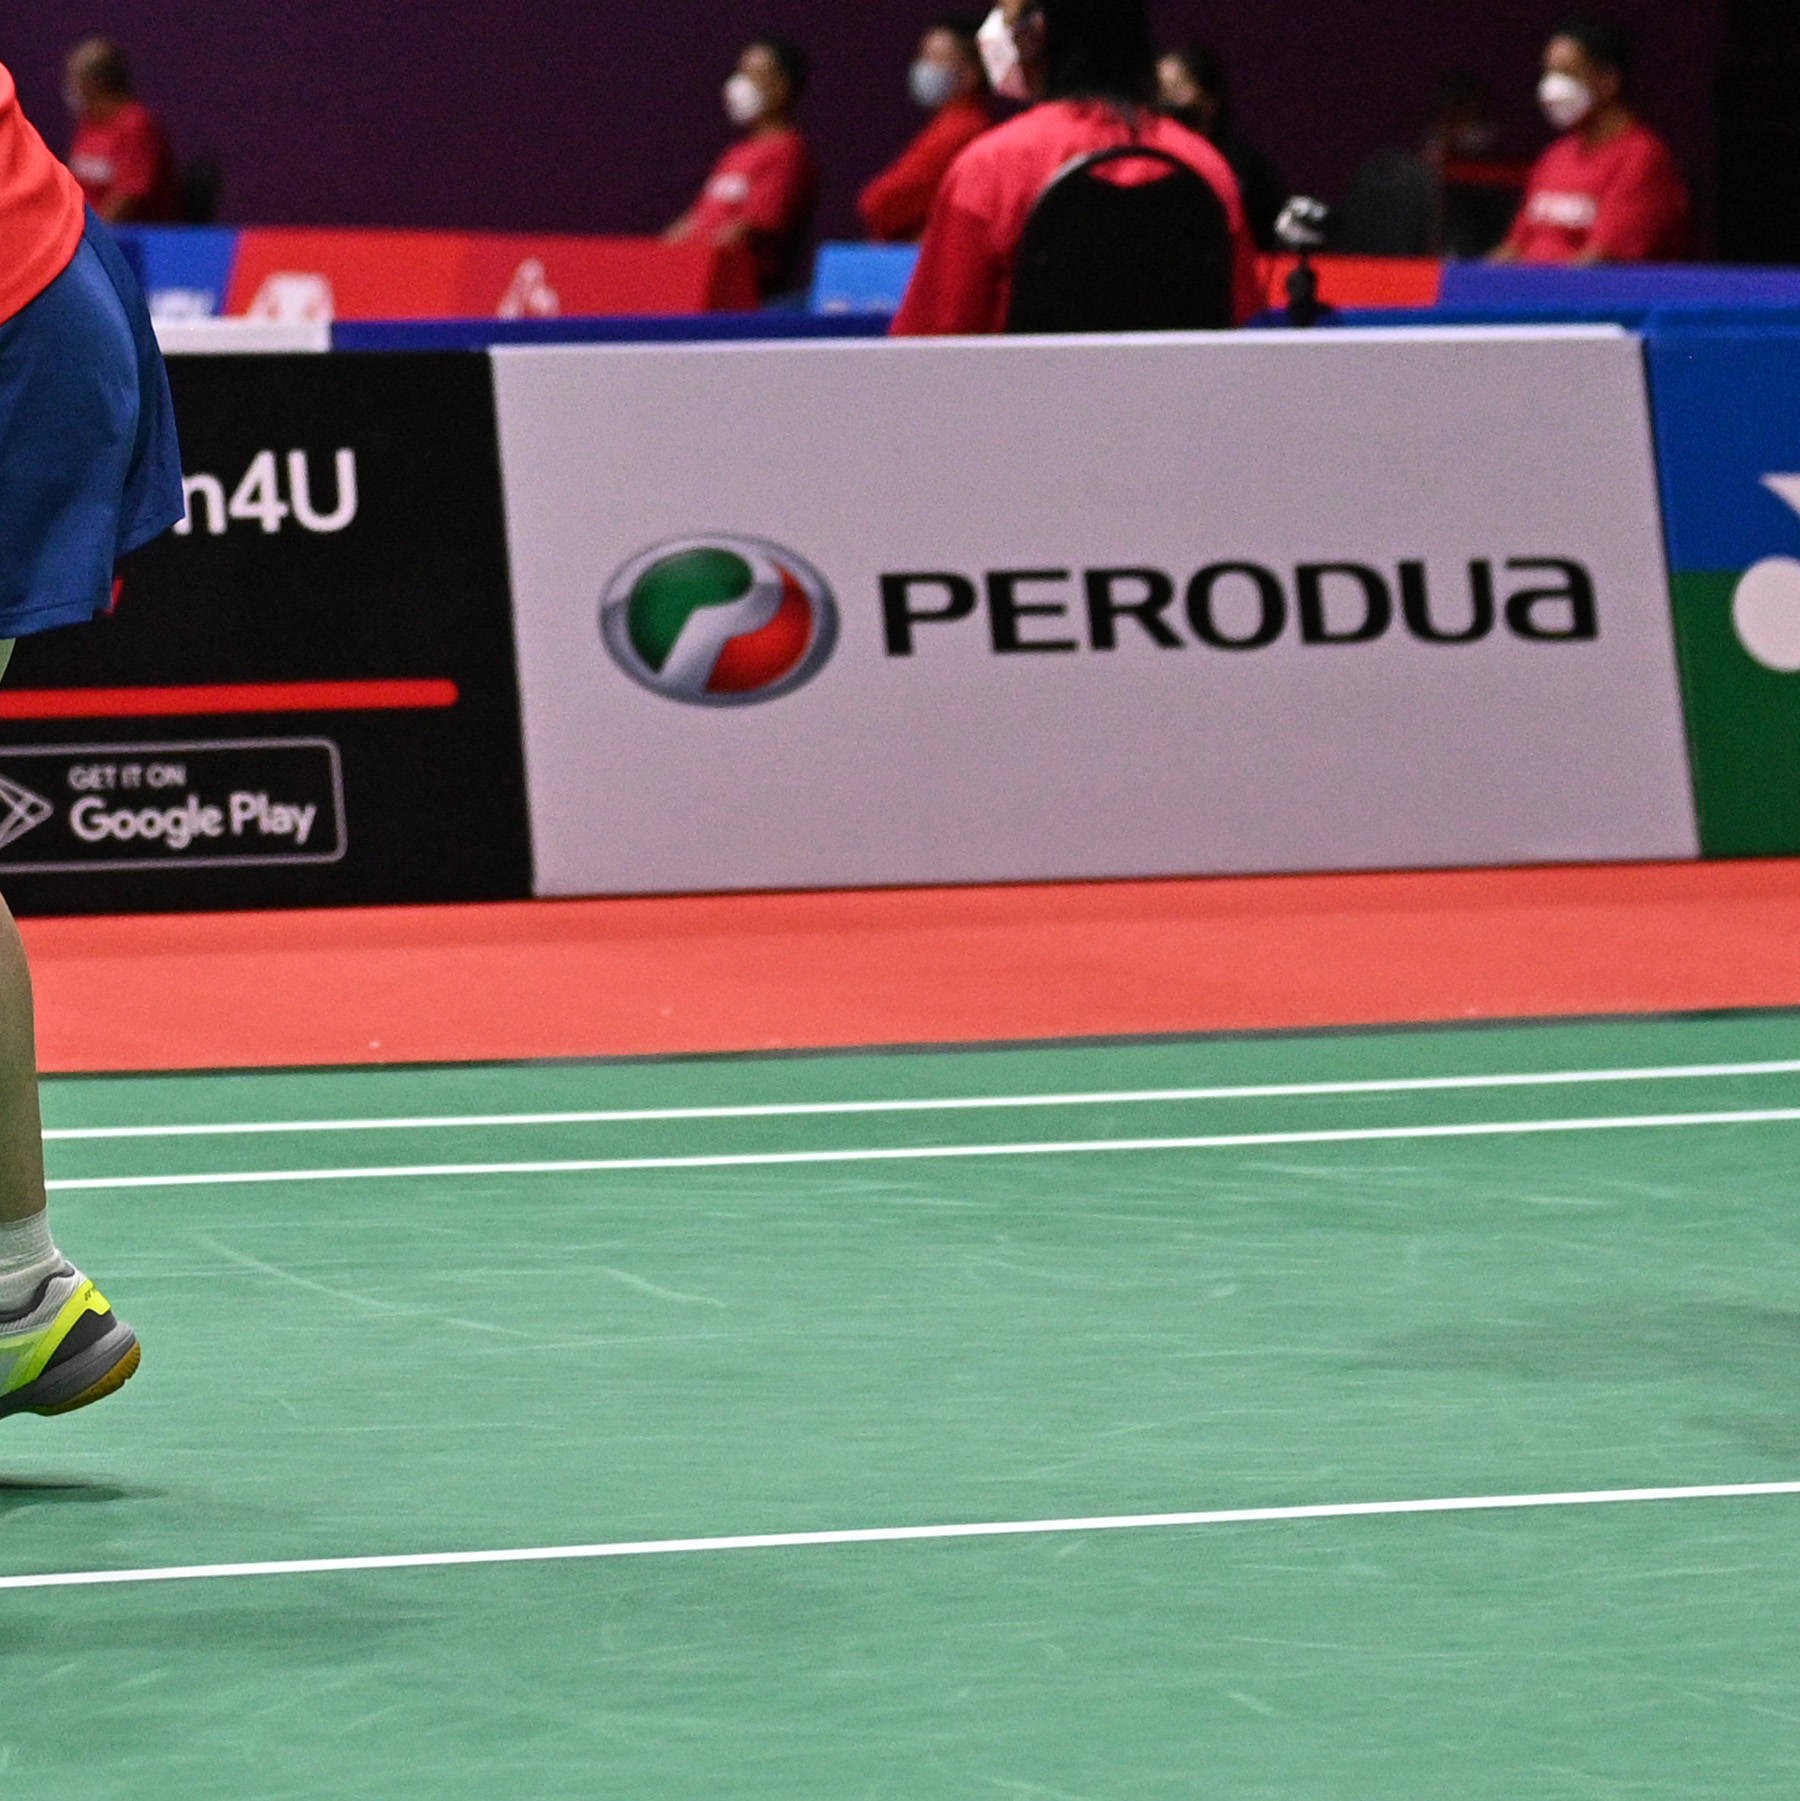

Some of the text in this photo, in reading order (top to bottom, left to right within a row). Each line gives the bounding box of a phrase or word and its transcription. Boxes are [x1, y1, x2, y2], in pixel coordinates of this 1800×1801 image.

[67, 763, 186, 790] GET IT ON
[69, 791, 317, 849] Google Play
